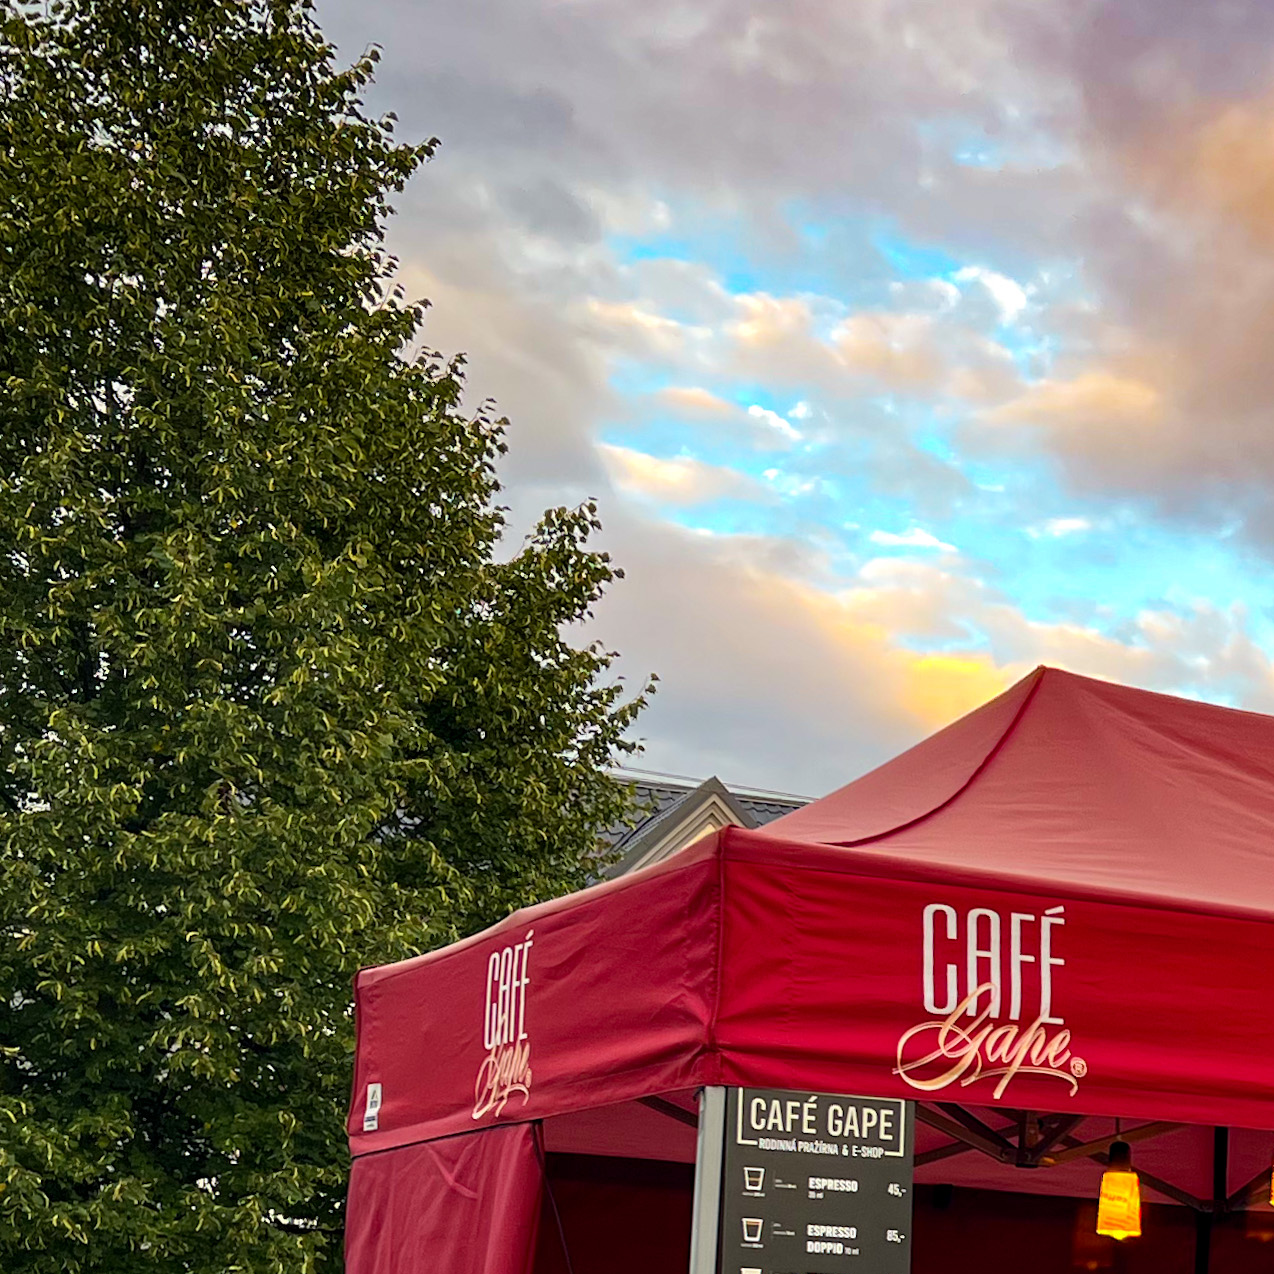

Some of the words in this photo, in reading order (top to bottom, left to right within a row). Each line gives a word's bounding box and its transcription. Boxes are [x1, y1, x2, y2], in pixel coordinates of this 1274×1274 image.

[922, 903, 1066, 1025] CAFÉ
[484, 929, 535, 1050] CAFÉ
[750, 1096, 818, 1134] CAFÉ
[827, 1104, 894, 1141] GAPE
[758, 1137, 797, 1152] RODINNÁ
[842, 1144, 849, 1156] &
[852, 1145, 884, 1158] E-SHOP
[808, 1177, 859, 1192] ESPRESSO
[807, 1224, 857, 1239] ESPRESSO
[806, 1240, 844, 1255] DOPPIO
